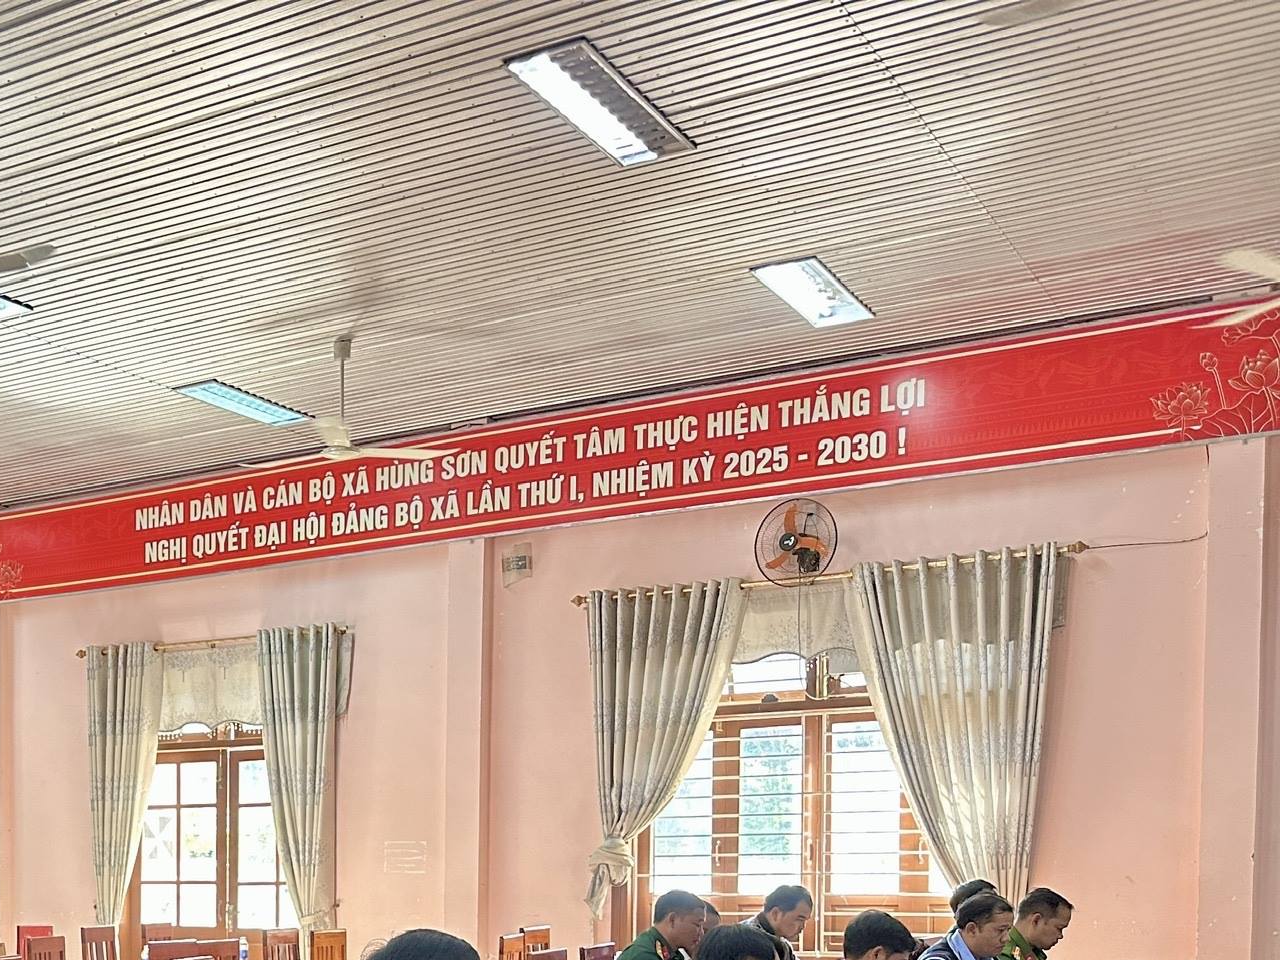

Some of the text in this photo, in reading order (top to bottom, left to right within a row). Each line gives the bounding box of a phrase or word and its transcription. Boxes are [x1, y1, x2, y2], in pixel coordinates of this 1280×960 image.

[135, 378, 925, 531] NHÂN DÂN VÀ CÁN BỘ XÃ HÙNG SƠN QUYẾT TÂM THỰC HIỆN THẮNG LỢI
[144, 536, 187, 563] NGHỊ
[192, 521, 249, 559] QUYẾT
[254, 521, 287, 550] ĐẠI
[293, 512, 326, 544] HỘI
[331, 502, 388, 536] ĐẢNG
[395, 495, 423, 529] BỘ
[430, 489, 460, 521] XÃ
[467, 479, 510, 516] LẦN
[517, 472, 564, 508] THỨ
[569, 475, 584, 503] I,
[593, 460, 673, 497] NHIỆM
[682, 450, 716, 485] KỲ
[723, 445, 789, 479] 2025
[817, 430, 887, 466] 2030
[897, 427, 906, 456] !
